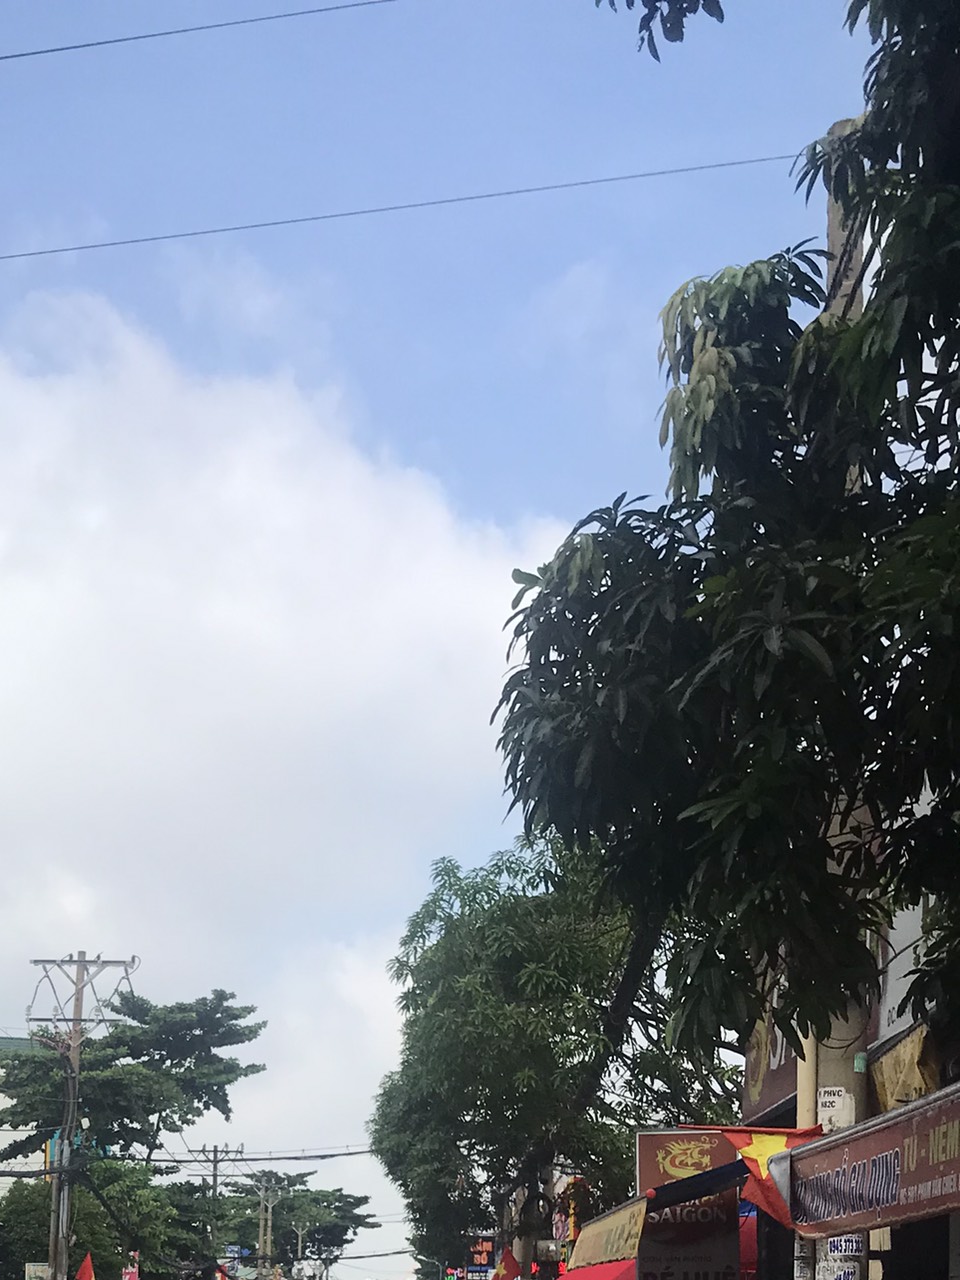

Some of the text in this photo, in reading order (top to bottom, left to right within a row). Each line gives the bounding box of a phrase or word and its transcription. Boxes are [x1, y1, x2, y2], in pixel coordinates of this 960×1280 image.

[849, 1160, 867, 1217] GIA
[867, 1147, 901, 1221] DỤNG
[647, 1206, 727, 1224] SAIGON
